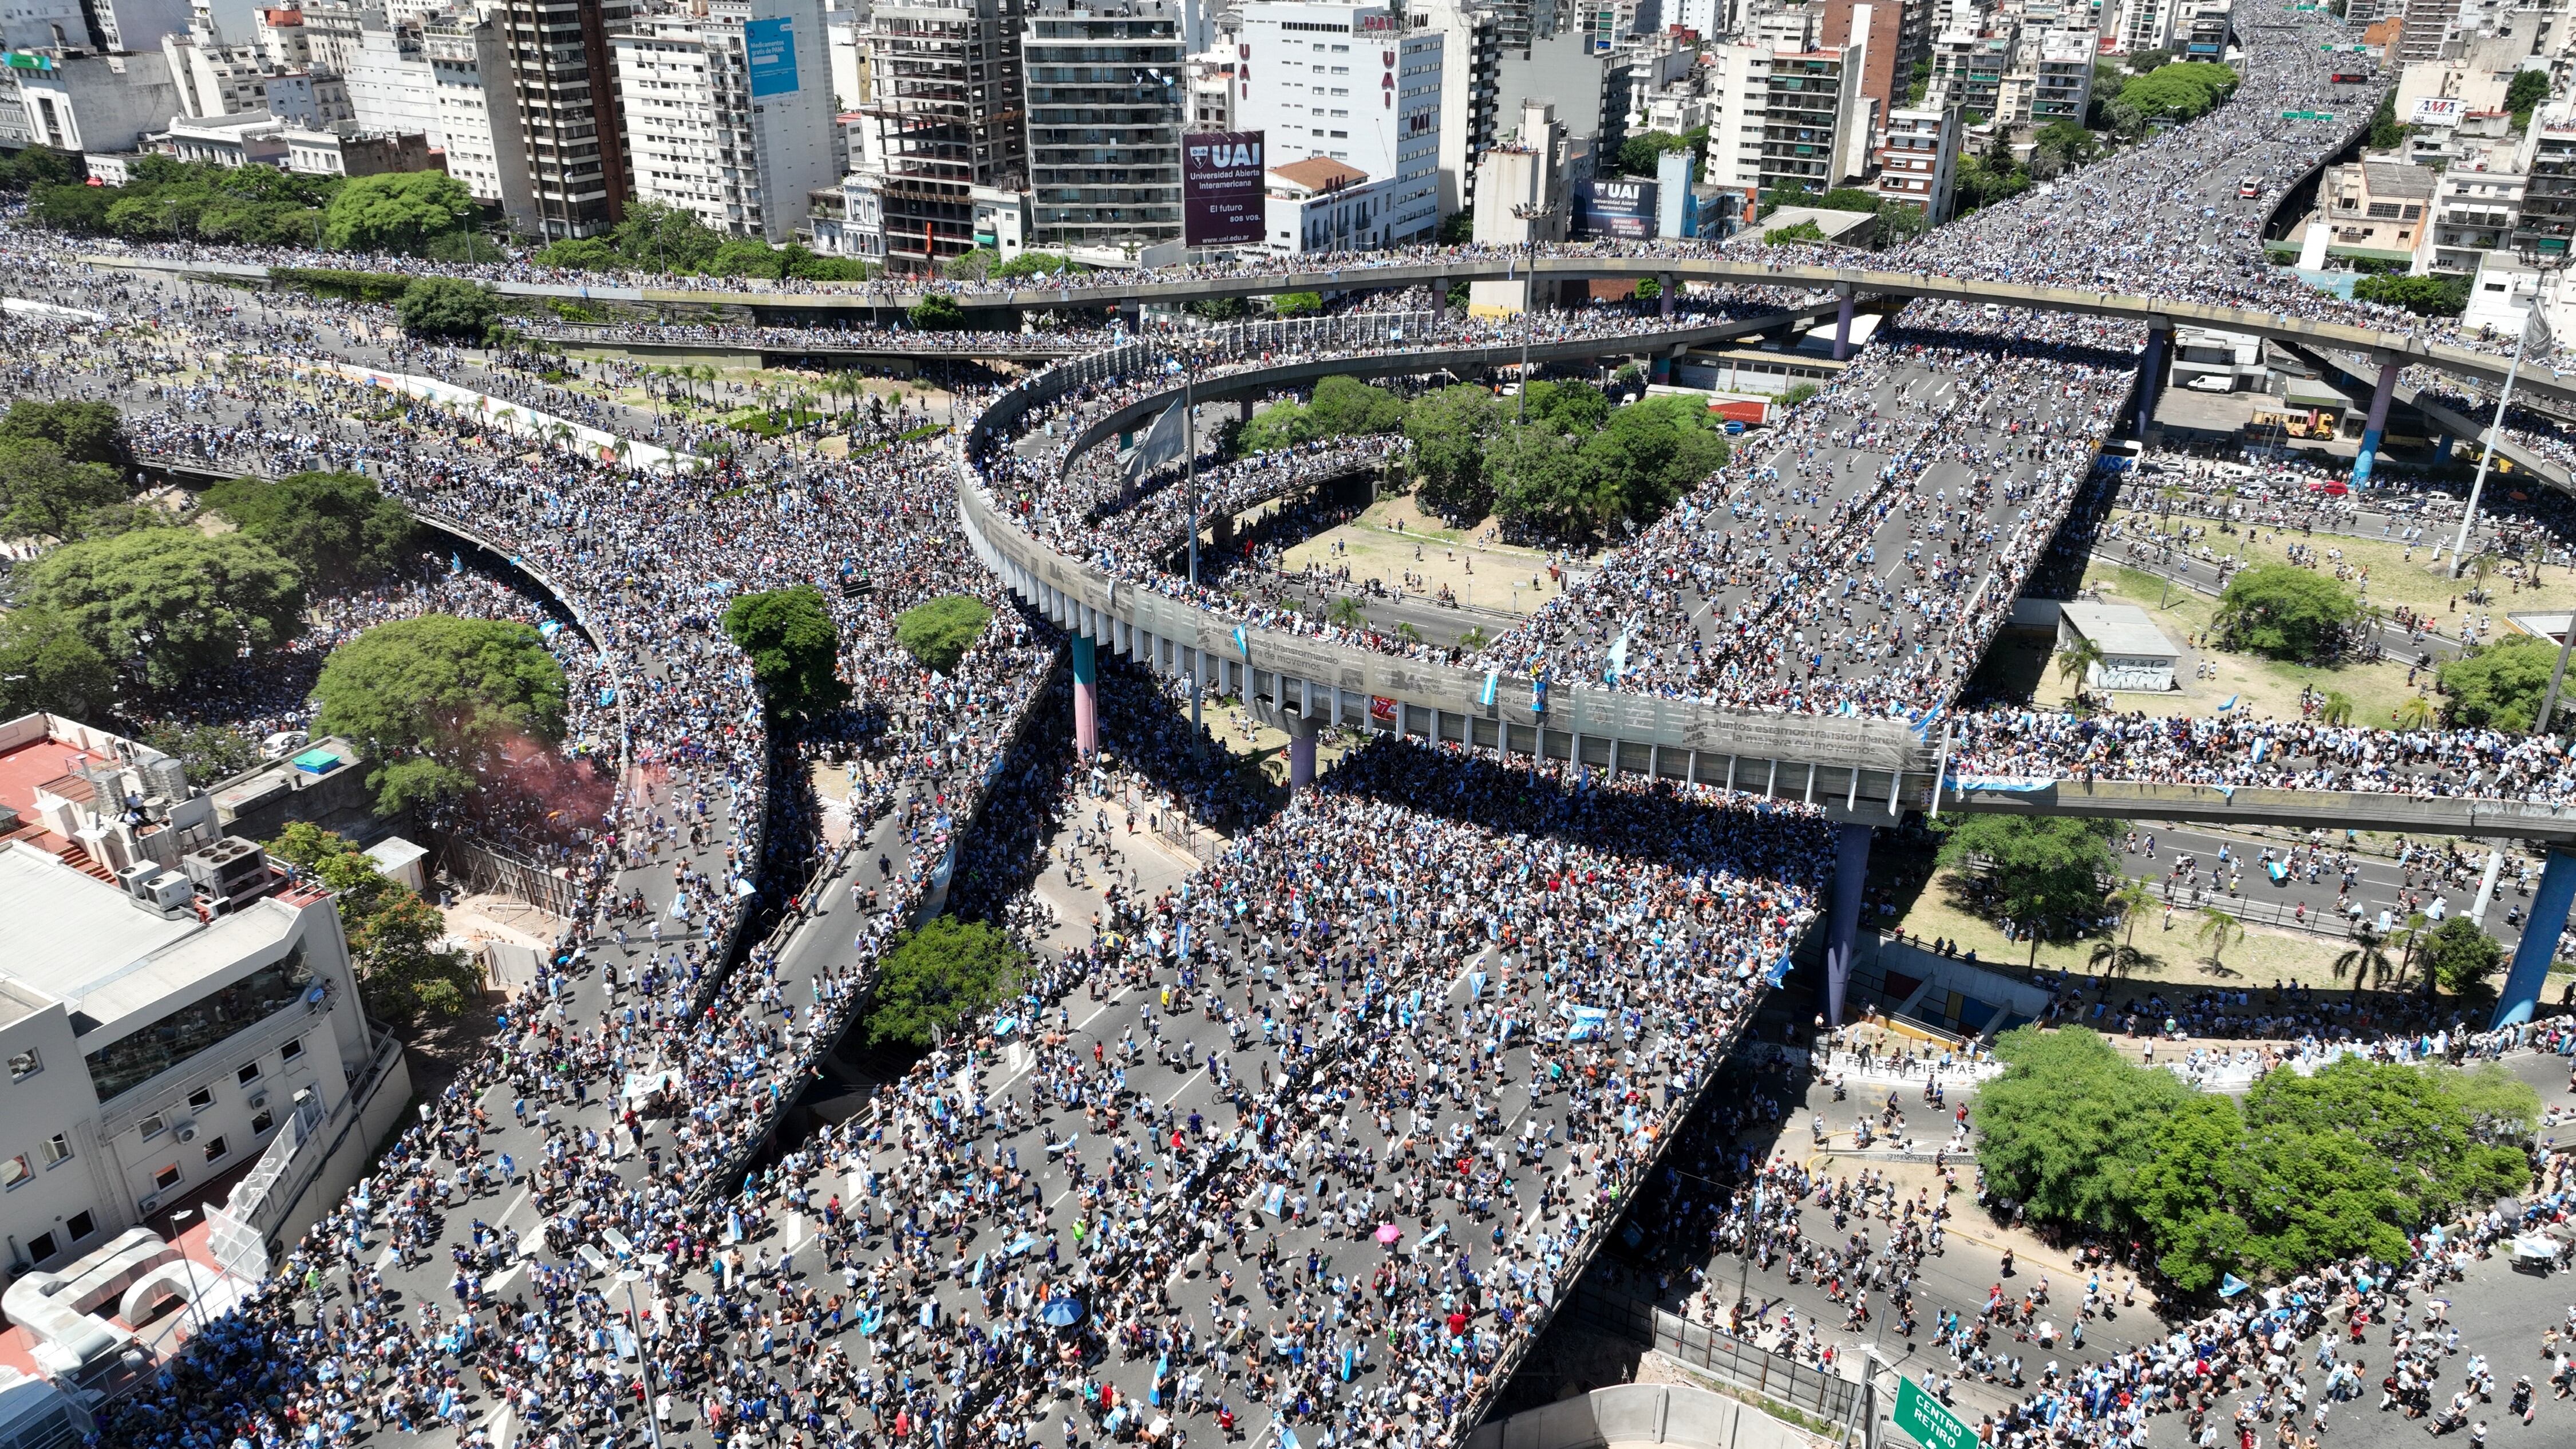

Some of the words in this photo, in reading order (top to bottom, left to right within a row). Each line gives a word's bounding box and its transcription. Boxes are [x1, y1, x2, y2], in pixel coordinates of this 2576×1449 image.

[1365, 15, 1393, 30] UAI
[1414, 14, 1428, 27] UAI
[1239, 44, 1250, 100] UAI
[1382, 51, 1395, 109] UAI
[2417, 101, 2455, 113] AMA
[1411, 115, 1429, 131] UAI
[1212, 143, 1259, 168] UAI
[1191, 171, 1233, 180] Universidad
[1199, 180, 1251, 189] Interamericana
[1608, 183, 1639, 199] UAI
[1220, 204, 1242, 212] futuro
[1202, 235, 1249, 243] www.uai.edu.ar
[1224, 638, 1231, 647] la
[1233, 641, 1264, 657] mera
[1265, 650, 1275, 660] de
[1278, 654, 1323, 672] movernos.
[1273, 642, 1339, 665] transformando
[1420, 676, 1442, 684] Buenos
[2098, 674, 2171, 692] KARMA
[1425, 688, 1447, 697] Ciudad
[1512, 696, 1527, 705] del
[1712, 719, 1752, 732] Juntos
[1756, 725, 1807, 737] estamos
[1810, 729, 1902, 745] transformando
[1732, 732, 1743, 742] la
[1745, 735, 1791, 747] manera
[1795, 738, 1809, 748] de
[1814, 742, 1879, 755] movernos.
[1916, 1395, 1962, 1438] CENTRO
[1914, 1408, 1956, 1448] RETIRO
